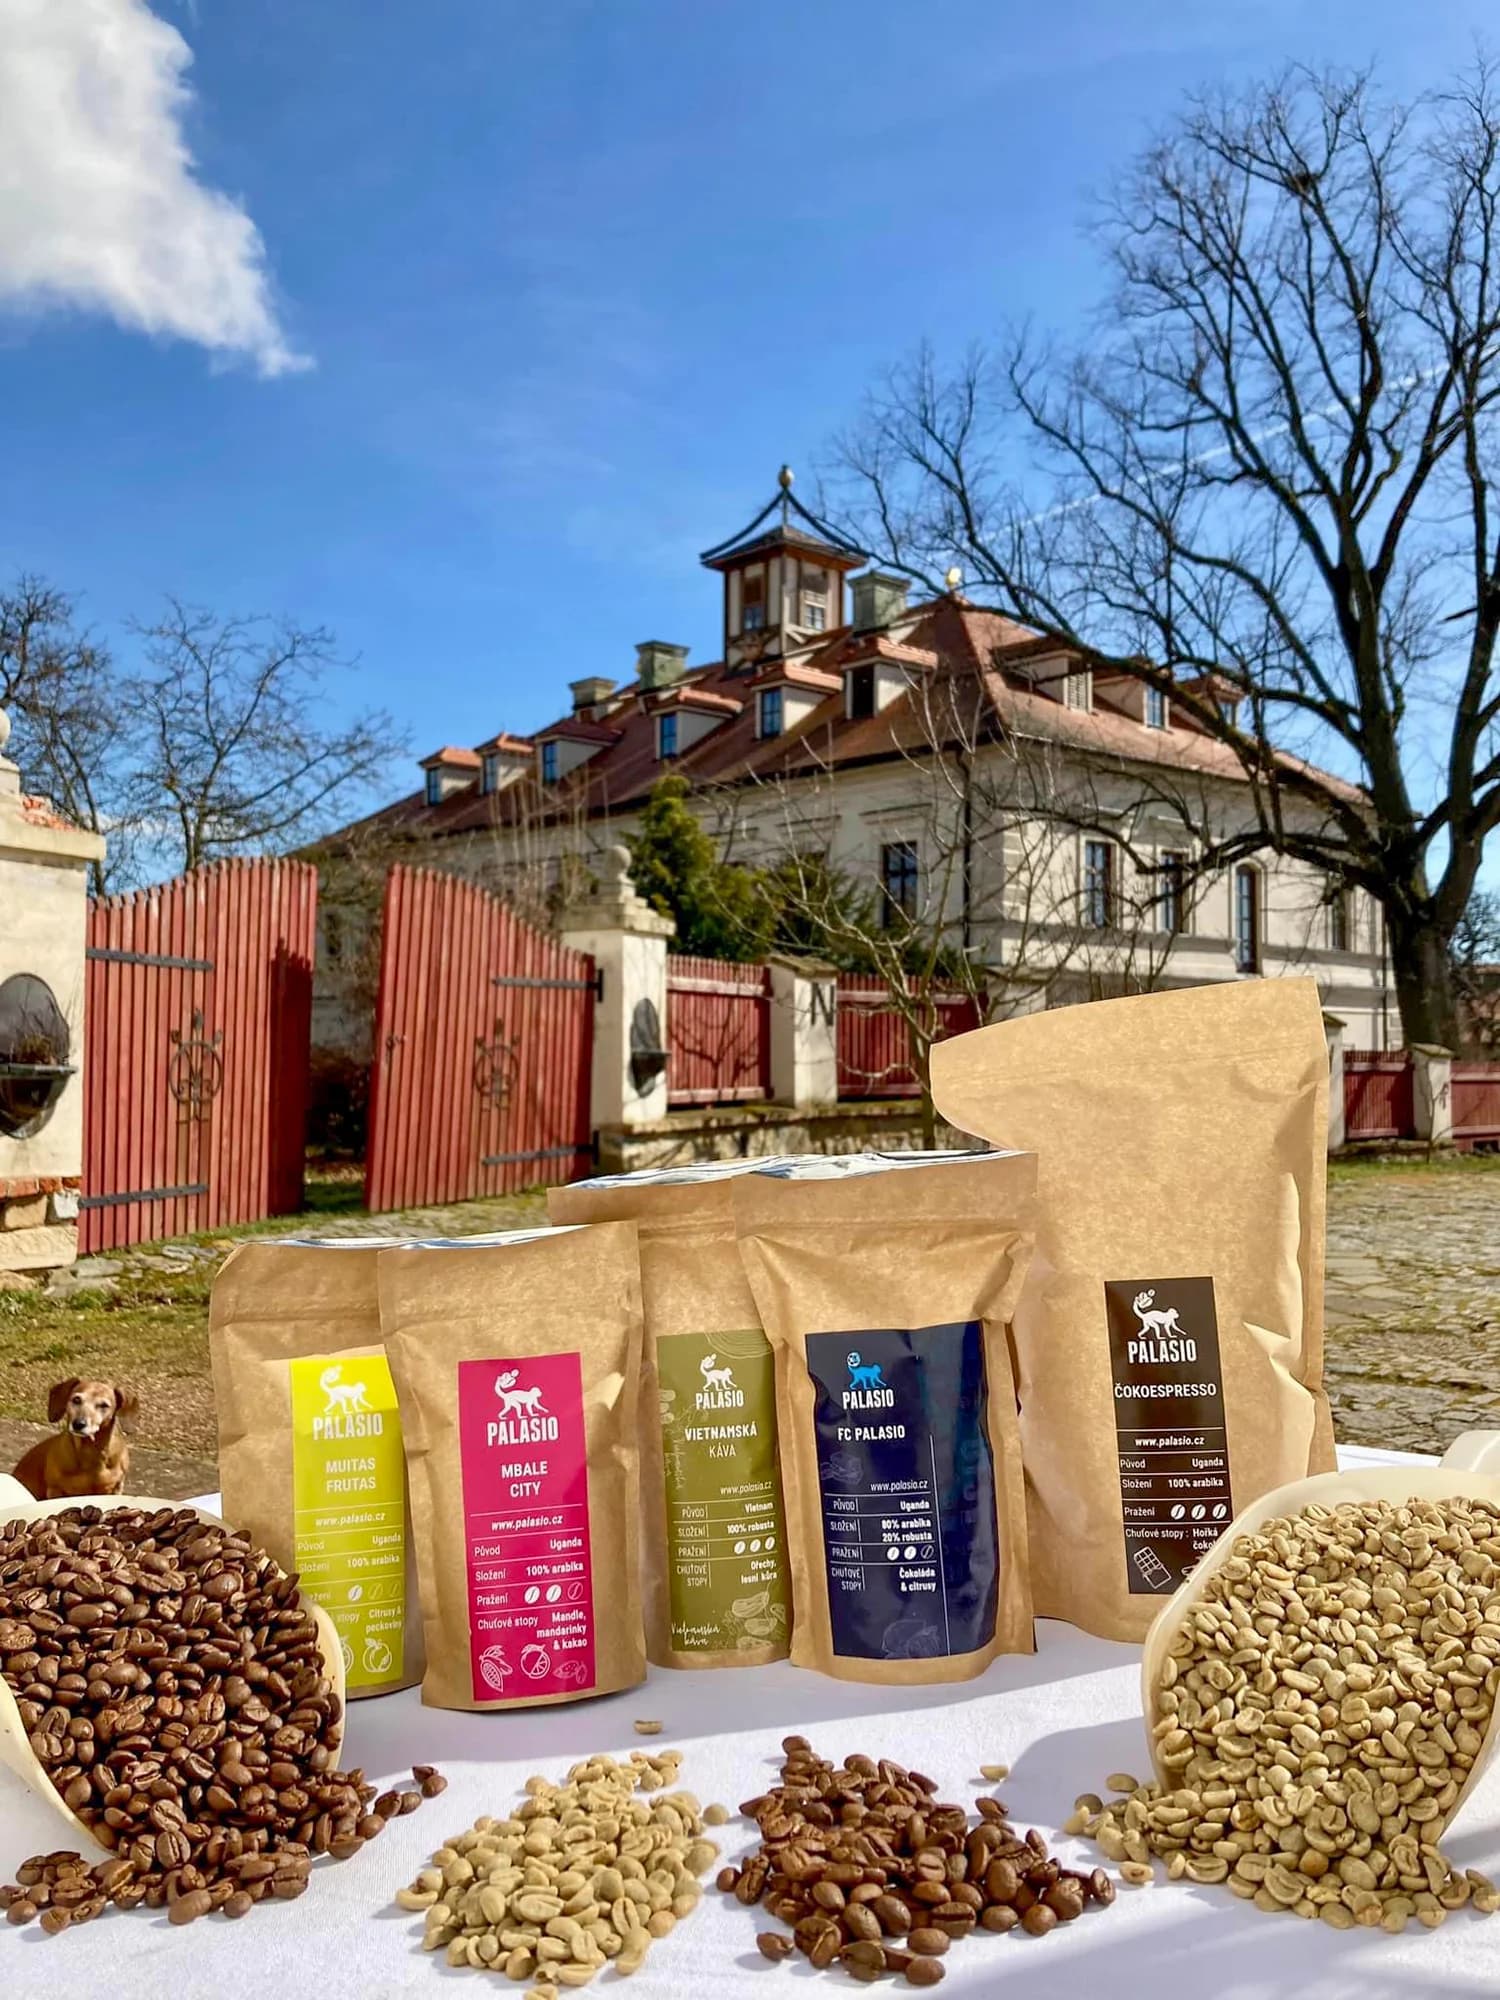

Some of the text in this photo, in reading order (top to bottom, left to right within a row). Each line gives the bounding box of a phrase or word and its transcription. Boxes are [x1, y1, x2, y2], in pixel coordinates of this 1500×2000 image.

[1127, 1339, 1197, 1364] PALASIO
[1114, 1383, 1217, 1398] ČOKOESPRESSO
[695, 1390, 744, 1410] PALASIO
[842, 1389, 894, 1410] PALASIO
[313, 1413, 383, 1441] PALASIO
[487, 1417, 559, 1447] PALASIO
[684, 1421, 758, 1441] VIETNAMSKÁ
[838, 1425, 905, 1441] FC PALASIO
[1135, 1436, 1205, 1448] www.palasio.cz
[709, 1442, 736, 1459] KÁVA
[326, 1457, 376, 1473] MUITAS
[501, 1461, 548, 1479] MBALE
[1120, 1458, 1146, 1469] Původ
[1191, 1457, 1224, 1469] Uganda
[326, 1477, 376, 1493] FRUTAS
[510, 1481, 541, 1498] CITY
[720, 1481, 772, 1496] www.palasio.cz
[870, 1480, 928, 1493] www.palasio.cz
[1122, 1478, 1152, 1489] Složení
[1168, 1477, 1224, 1489] 100% arabika
[744, 1501, 774, 1514] Vietnam
[900, 1499, 930, 1511] Uganda
[1124, 1506, 1155, 1517] Pražení
[315, 1512, 386, 1527] www.palasio.cz
[491, 1514, 563, 1531] www.palasio.cz
[901, 1517, 931, 1529] arabika
[727, 1519, 774, 1535] 100% robusta
[1125, 1527, 1159, 1539] Chuťové
[1161, 1529, 1185, 1540] stopy
[1192, 1527, 1218, 1538] Hořká
[372, 1533, 401, 1547] Uganda
[882, 1531, 932, 1542] 20% robusta
[550, 1537, 582, 1551] Uganda
[1192, 1540, 1217, 1550] čoko
[474, 1546, 501, 1557] Původ
[347, 1554, 400, 1568] 100% arabika
[475, 1569, 506, 1582] Složení
[526, 1561, 584, 1577] 100% arabika
[899, 1566, 936, 1579] Čokoláda
[687, 1575, 708, 1587] STOPY
[841, 1580, 862, 1591] STOPY
[901, 1580, 936, 1592] & citrusy
[476, 1592, 508, 1606] Pražení
[477, 1615, 539, 1630] Chuťové stopy
[552, 1609, 586, 1623] Mandle,
[536, 1624, 587, 1639] mandarinky
[553, 1638, 588, 1650] & kakao
